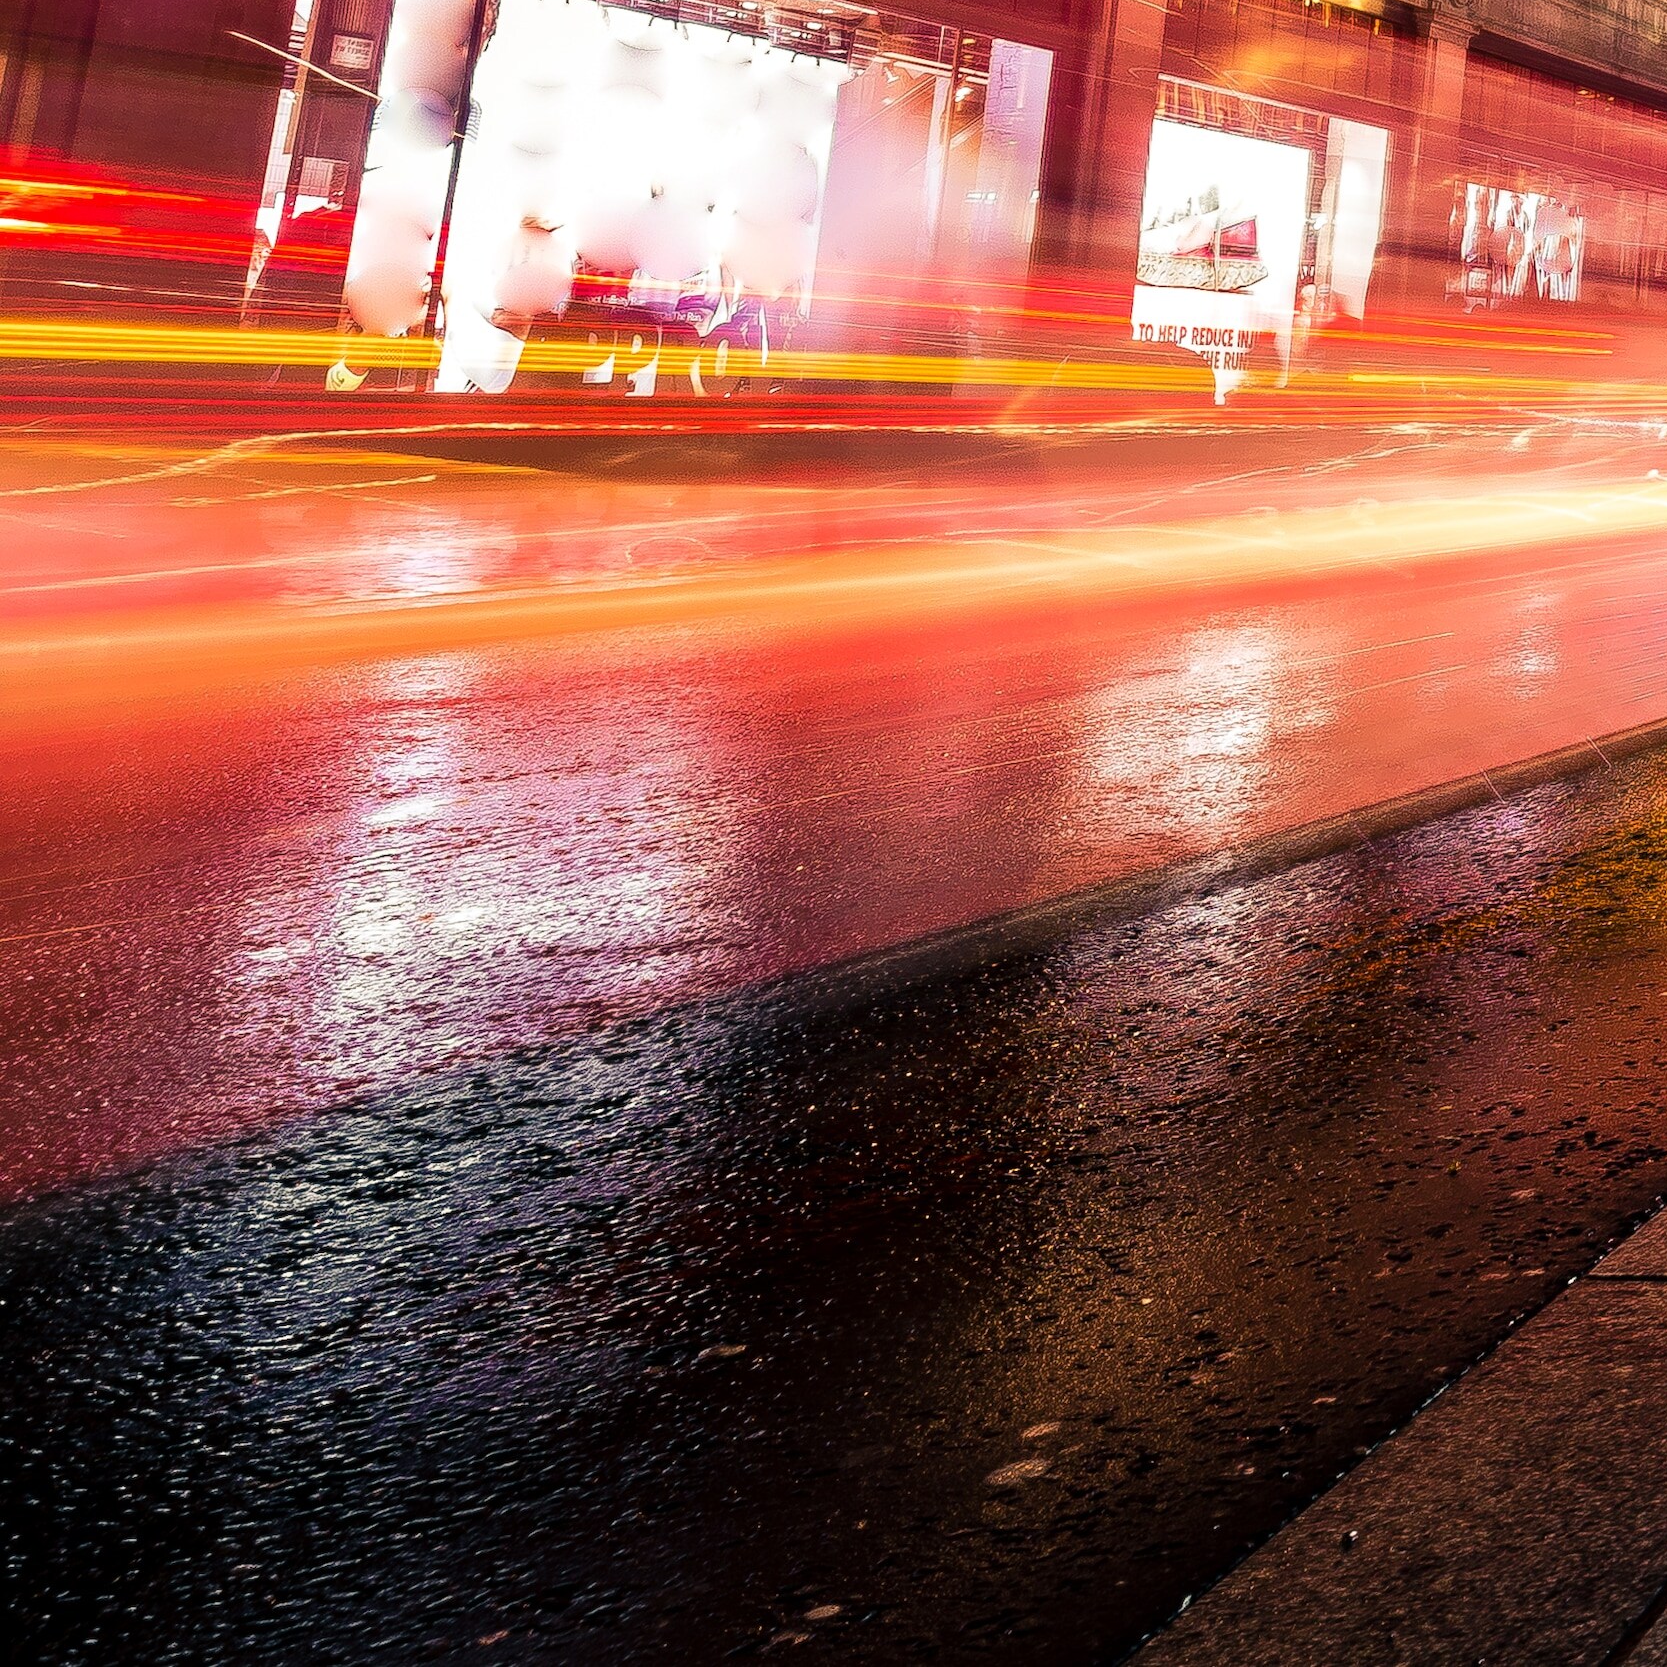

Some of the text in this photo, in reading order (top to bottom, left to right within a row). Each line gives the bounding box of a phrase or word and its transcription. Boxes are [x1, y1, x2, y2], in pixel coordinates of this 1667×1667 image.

[1139, 323, 1153, 342] TO
[1159, 324, 1187, 344] HELP
[1191, 327, 1234, 347] REDUCE
